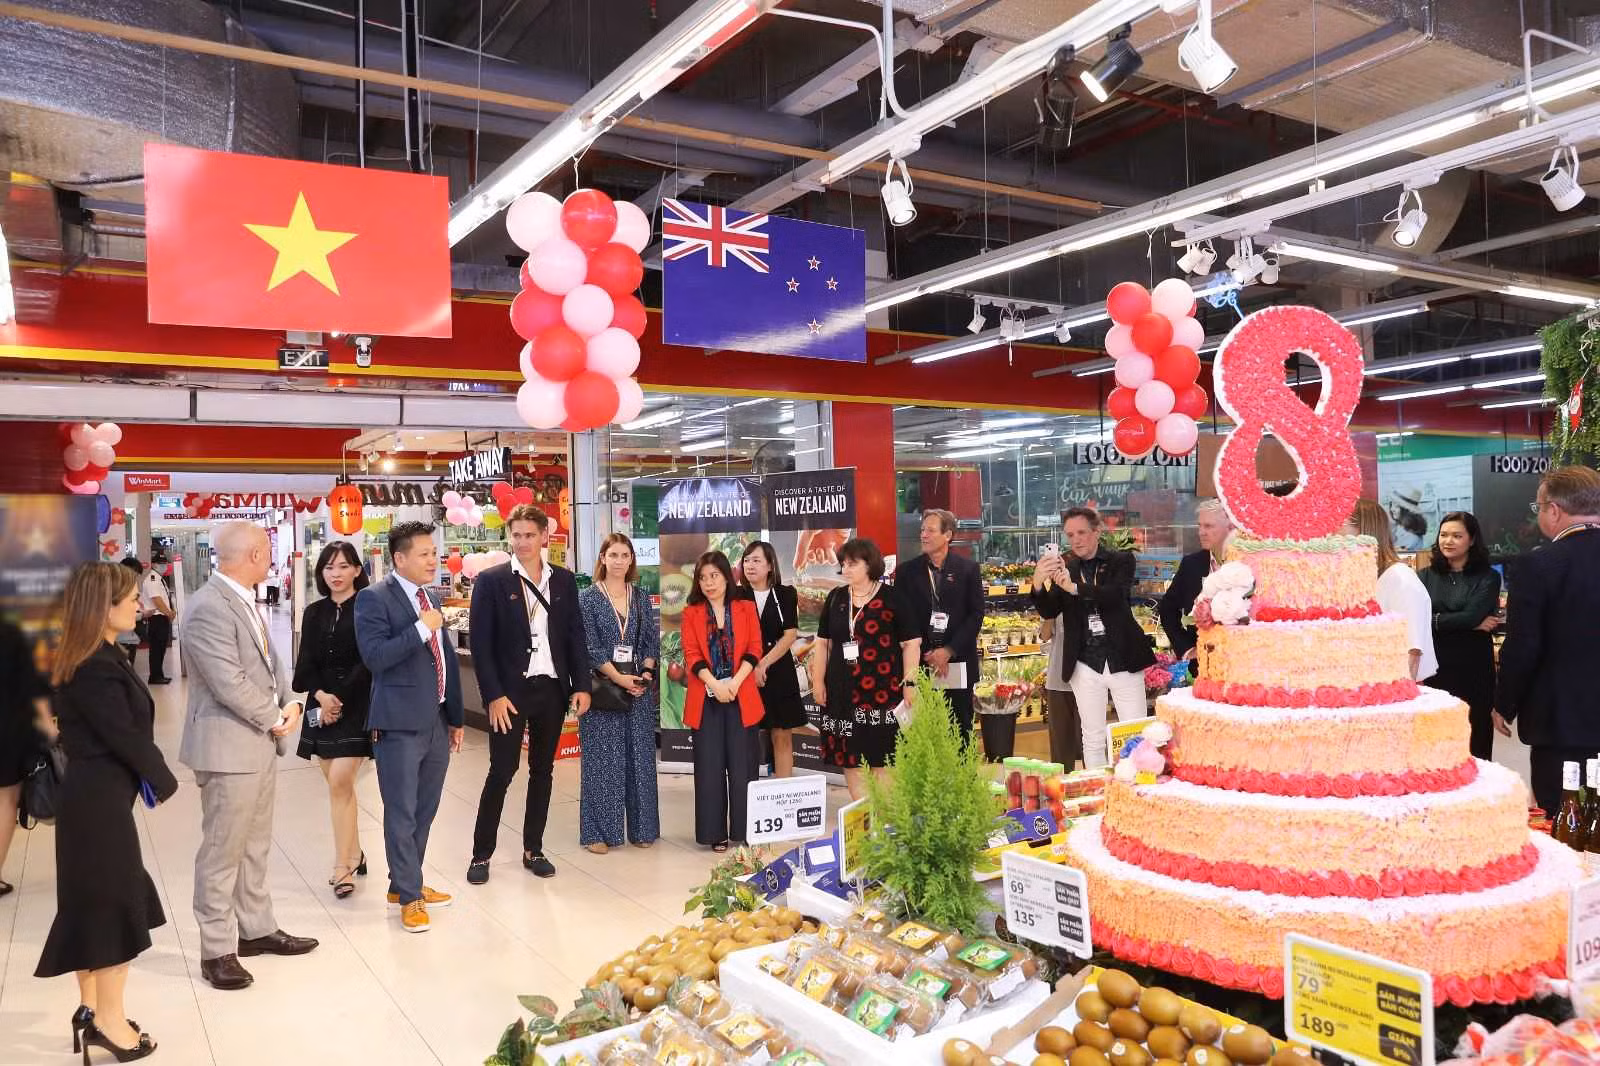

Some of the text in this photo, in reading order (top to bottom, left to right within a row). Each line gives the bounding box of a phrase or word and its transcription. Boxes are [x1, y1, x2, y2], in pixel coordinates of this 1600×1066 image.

[284, 351, 324, 366] EXIT
[1073, 442, 1137, 466] FOO
[449, 448, 505, 485] TAKE AWAY
[1494, 456, 1553, 473] FOOD ZO
[128, 477, 162, 485] WinMart
[774, 487, 807, 496] DISCOVER
[814, 485, 835, 494] TASTE
[836, 484, 846, 492] OF
[696, 499, 752, 518] ZEALAND
[775, 494, 847, 516] NEW ZEALAND
[754, 817, 783, 834] 139
[1010, 880, 1024, 894] 69
[1014, 909, 1035, 926] 135
[1296, 972, 1320, 993] 79
[1300, 1012, 1336, 1038] 189
